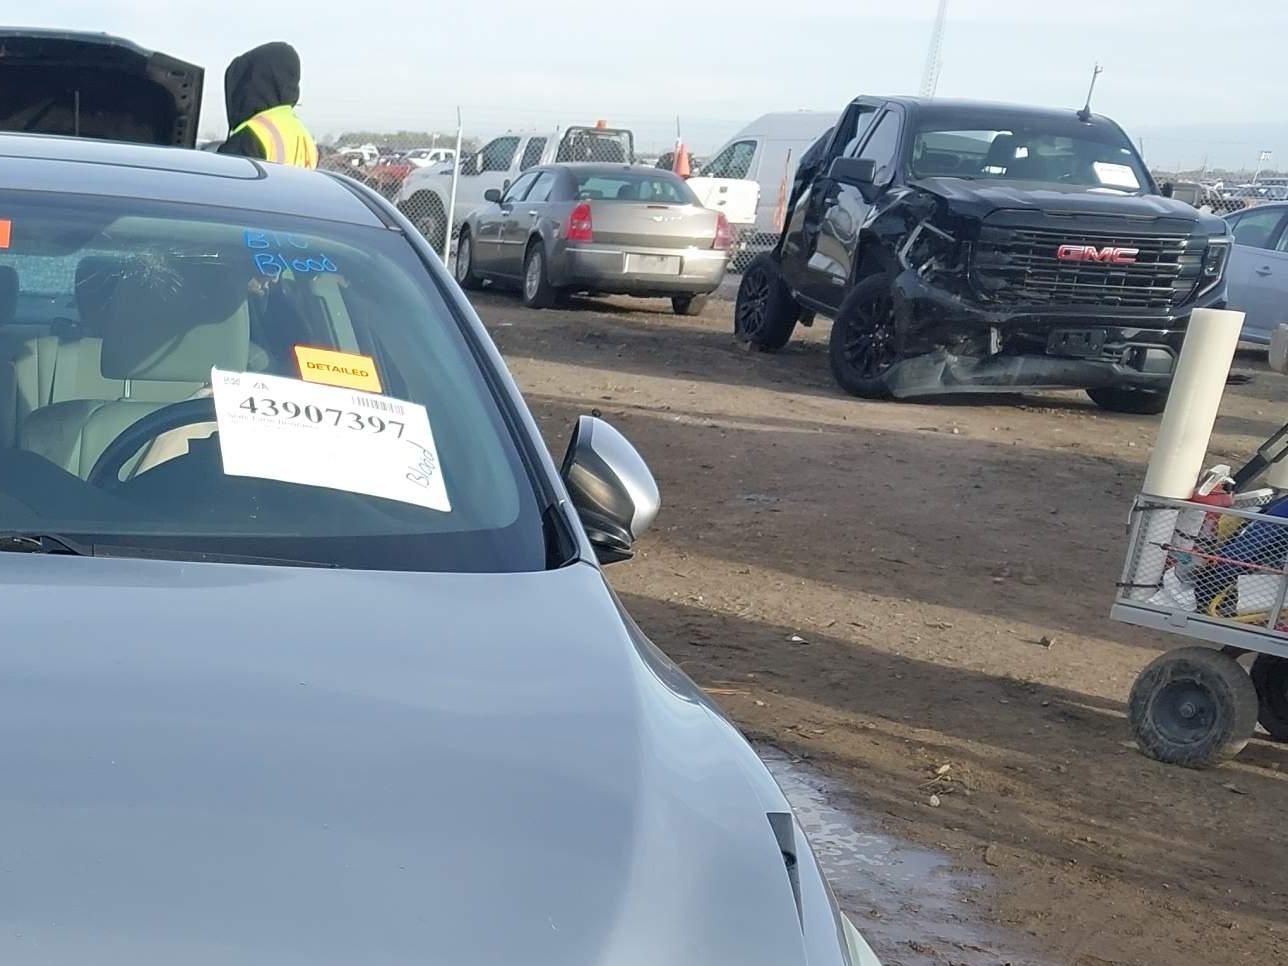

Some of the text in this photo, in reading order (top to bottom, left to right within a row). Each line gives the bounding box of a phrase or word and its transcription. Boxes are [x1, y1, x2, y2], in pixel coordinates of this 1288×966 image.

[254, 252, 338, 278] Blood
[1057, 244, 1139, 264] GMC
[306, 360, 369, 378] DETAILED
[239, 396, 405, 440] 43907397
